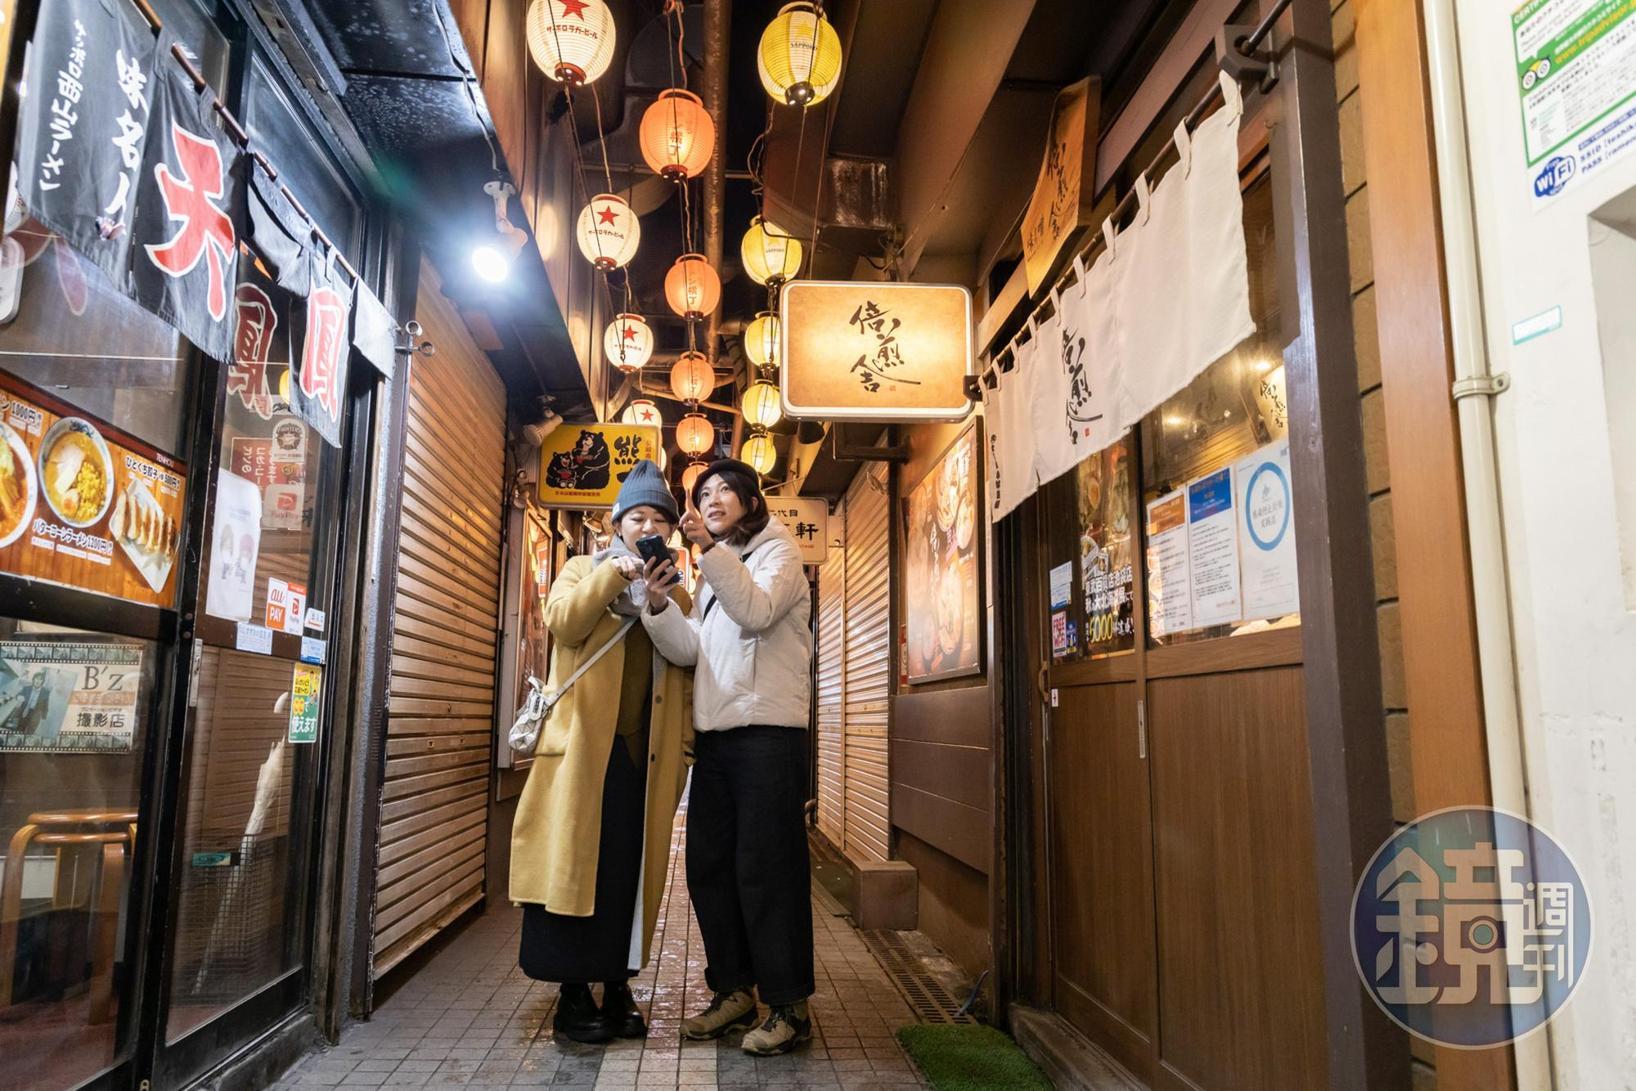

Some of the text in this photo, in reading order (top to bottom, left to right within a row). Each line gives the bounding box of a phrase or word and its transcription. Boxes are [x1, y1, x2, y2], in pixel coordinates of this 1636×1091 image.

[39, 19, 87, 191] サッポロ西山ラーメン
[271, 588, 285, 603] au
[270, 606, 285, 623] PAY
[81, 666, 124, 691] B'z
[77, 712, 125, 728] 撮影店
